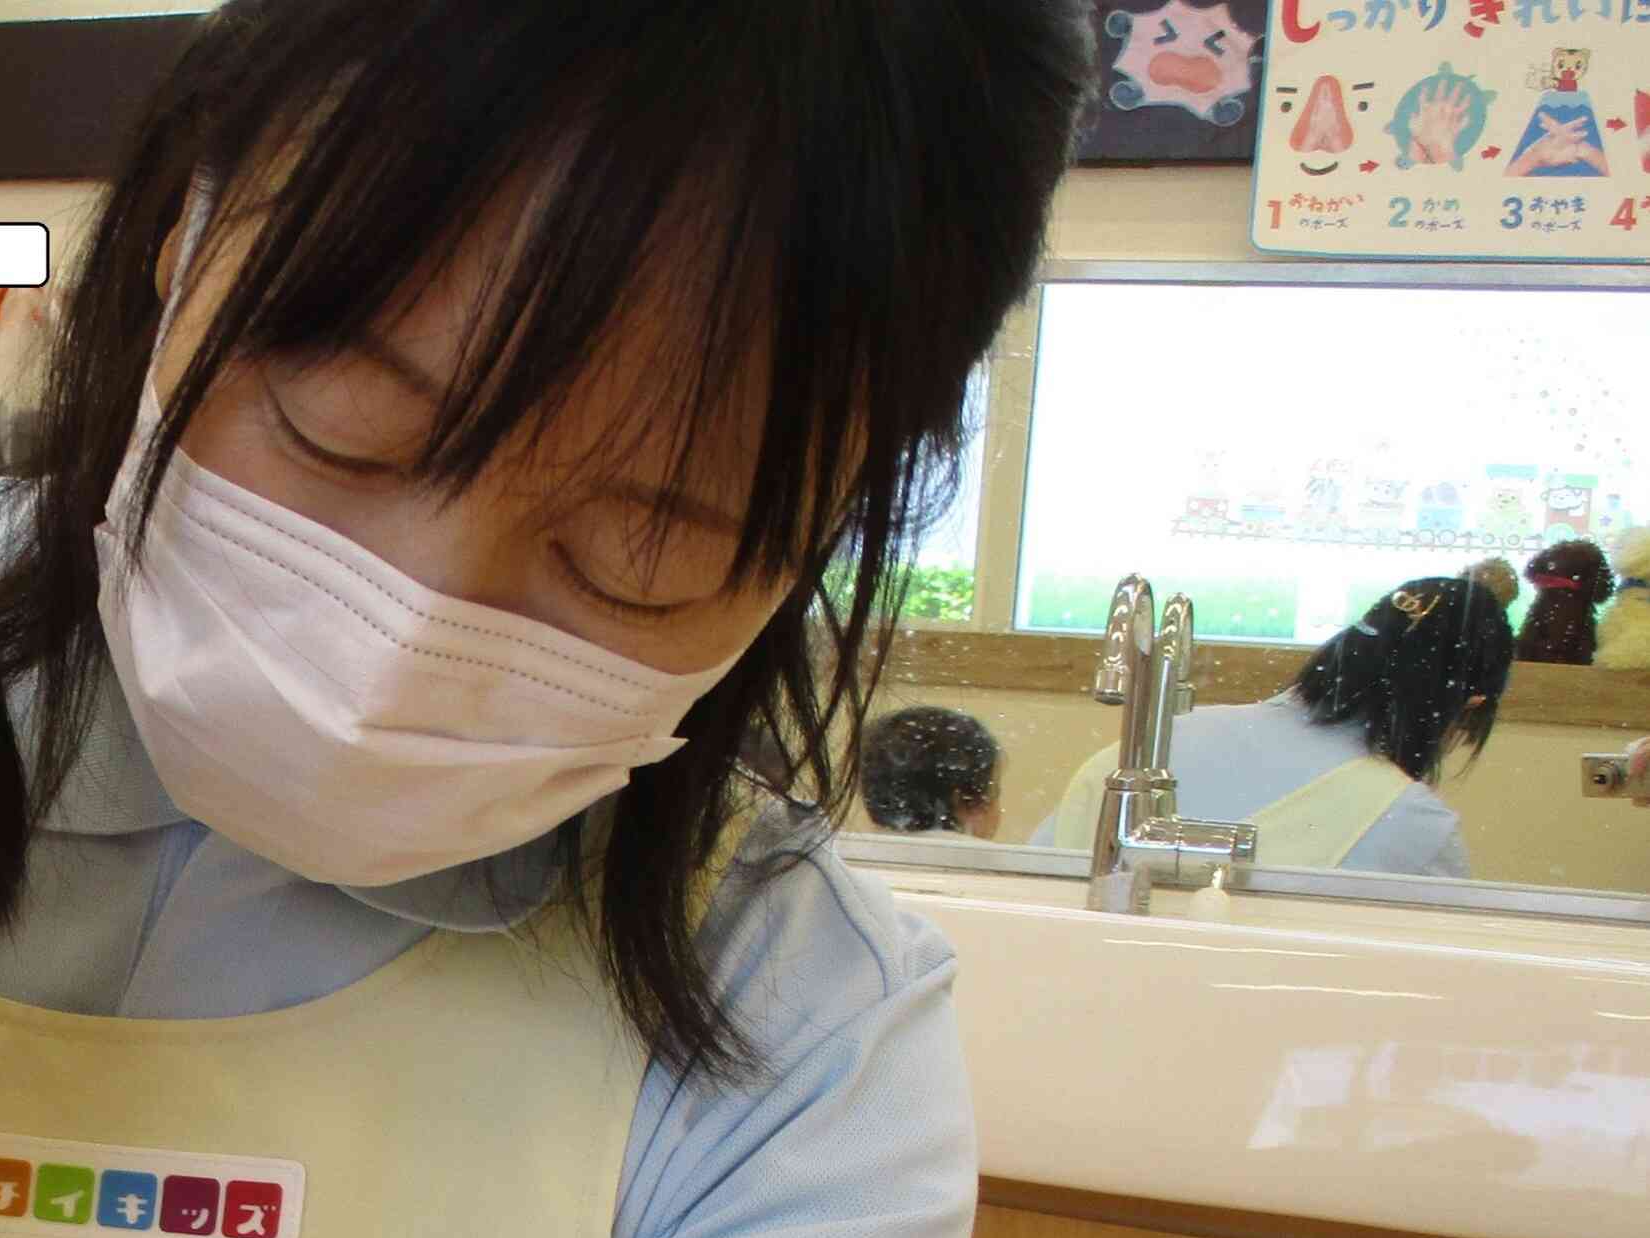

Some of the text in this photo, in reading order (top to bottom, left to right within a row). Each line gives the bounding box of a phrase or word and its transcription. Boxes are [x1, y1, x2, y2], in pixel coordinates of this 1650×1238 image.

[1268, 199, 1282, 229] 1
[1388, 196, 1412, 228] 2
[1500, 196, 1524, 230] 3
[1609, 198, 1637, 231] 4
